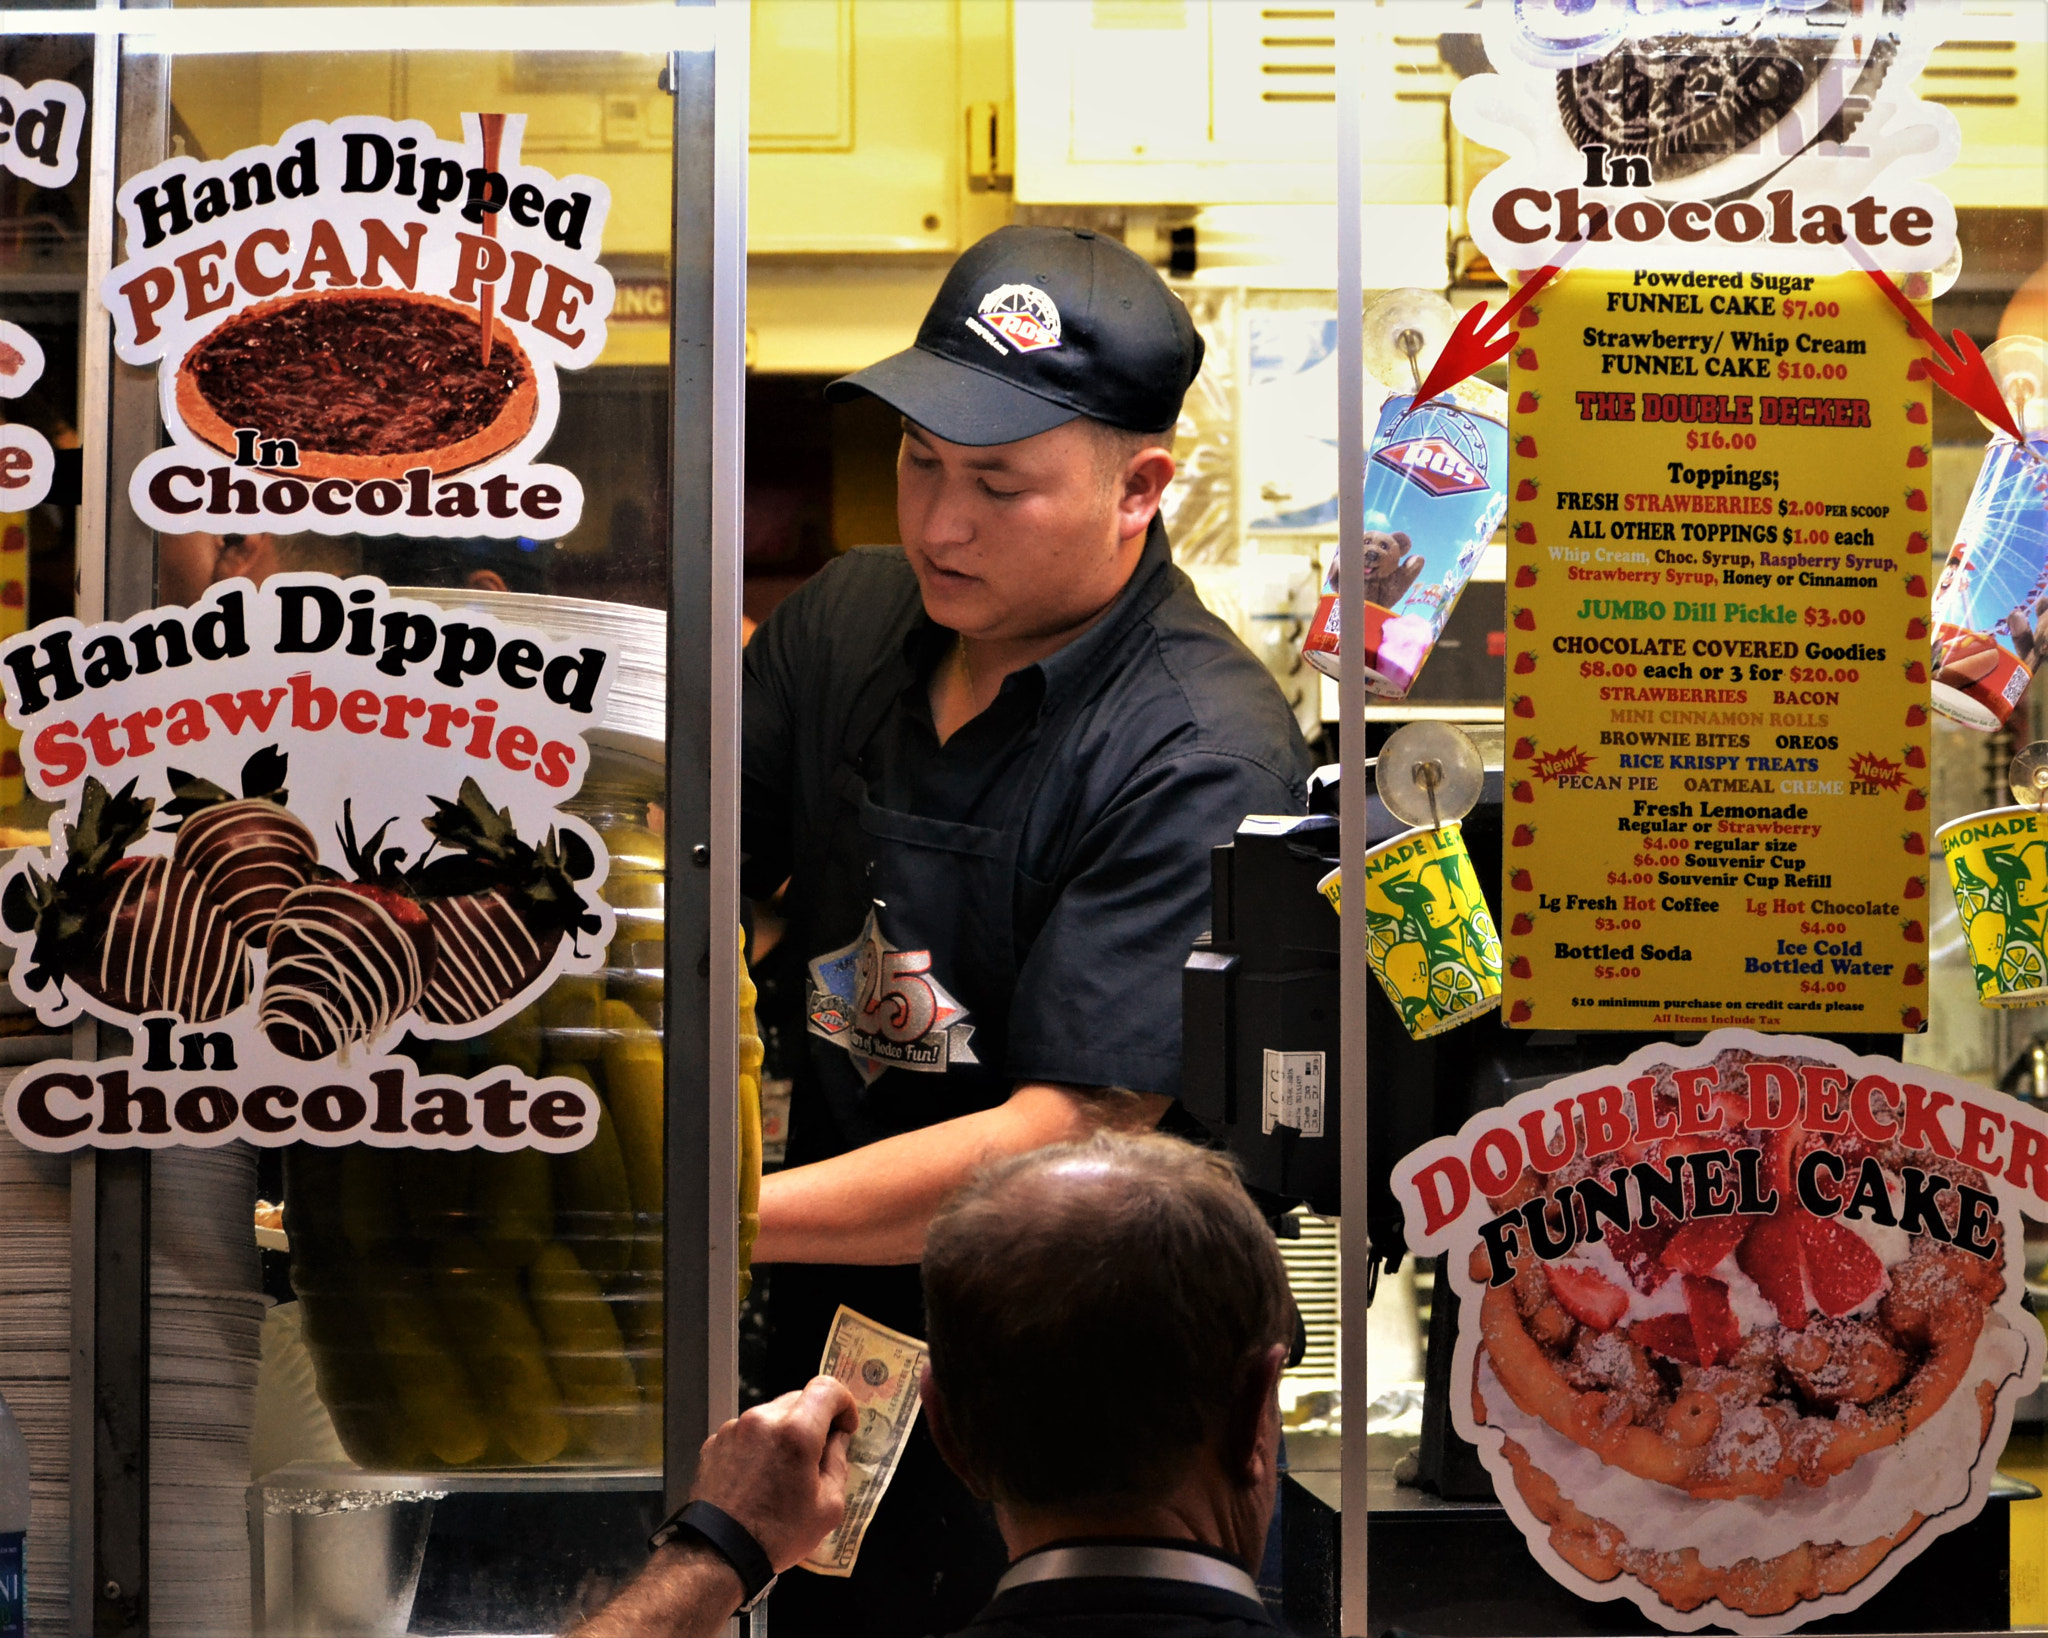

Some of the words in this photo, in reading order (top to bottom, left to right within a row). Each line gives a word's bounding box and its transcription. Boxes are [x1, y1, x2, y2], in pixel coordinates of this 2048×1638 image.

[1582, 144, 1652, 188] In
[135, 138, 318, 249] Hand
[342, 133, 592, 250] Dipped
[1492, 188, 1934, 246] Chocolate
[119, 219, 428, 346] PECAN
[451, 231, 594, 349] PIE
[1633, 269, 1743, 289] Powdered
[1751, 272, 1814, 295] Sugar
[1607, 292, 1703, 315] FUNNEL
[1710, 295, 1775, 316] CAKE
[1783, 298, 1840, 320] $7.00
[1583, 327, 1724, 354] Strawberry/
[1731, 330, 1789, 357] Whip
[1796, 333, 1867, 355] Cream
[1601, 354, 1698, 376] FUNNEL
[1705, 357, 1770, 378] CAKE
[1777, 360, 1847, 382] $10.00
[1576, 391, 1635, 421] THE
[1642, 393, 1753, 425] DOUBLE
[1760, 396, 1871, 428] DECKER
[233, 429, 299, 467] In
[1686, 429, 1757, 451] $16.00
[1667, 462, 1779, 491] Toppings;
[149, 465, 562, 520] Chocolate
[1556, 492, 1619, 511] FRESH
[1624, 494, 1773, 515] STRAWBERRIES
[1825, 505, 1848, 517] PER
[1851, 506, 1889, 518] SCOOP
[1569, 520, 1606, 539] ALL
[1611, 521, 1676, 541] OTHER
[1681, 523, 1777, 543] TOPPINGS
[1783, 527, 1829, 546] $1.00
[1834, 528, 1874, 546] each
[1549, 546, 1590, 564] Whip
[1595, 548, 1650, 566] Cream,
[1655, 549, 1698, 564] Choc.
[1702, 550, 1755, 568] Syrup,
[1760, 551, 1841, 570] Raspberry
[1846, 554, 1898, 572] Syrup,
[1568, 566, 1661, 585] Strawberry
[1666, 568, 1718, 587] Syrup,
[1723, 570, 1772, 588] Honey
[1777, 574, 1794, 587] or
[1799, 572, 1877, 588] Cinnamon
[1577, 599, 1666, 621] JUMBO
[1673, 601, 1717, 622] Dill
[1724, 603, 1797, 624] Pickle
[1804, 606, 1866, 627] $3.00
[4, 590, 250, 716] Hand
[273, 584, 607, 714] Dipped
[1553, 636, 1686, 656] CHOCOLATE
[1692, 639, 1799, 659] COVERED
[1805, 642, 1886, 661] Goodies
[1580, 660, 1637, 679] $8.00
[1644, 662, 1692, 679] each
[1700, 667, 1723, 680] or
[1730, 666, 1743, 682] 3
[1749, 664, 1783, 681] for
[1790, 666, 1859, 683] $20.00
[1600, 687, 1748, 703] STRAWBERRIES
[1773, 690, 1839, 705] BACON
[33, 670, 576, 788] Strawberries
[1610, 709, 1654, 723] MINI
[1659, 710, 1764, 727] CINNAMON
[1769, 712, 1829, 728] ROLLS
[1600, 731, 1690, 747] BROWNIE
[1696, 733, 1750, 748] BITES
[1775, 735, 1838, 750] OREOS
[1540, 751, 1579, 777] New!
[1619, 754, 1664, 769] RICE
[1669, 755, 1740, 771] KRISPY
[1746, 757, 1819, 772] TREATS
[1858, 761, 1898, 781] New!
[1557, 774, 1622, 790] PECAN
[1628, 776, 1658, 791] PIE
[1684, 778, 1774, 793] OATMEAL
[1780, 780, 1844, 795] CREME
[1849, 781, 1880, 796] PIE
[1633, 800, 1693, 817] Fresh
[1699, 801, 1808, 820] Lemonade
[1618, 817, 1687, 834] Regular
[1692, 822, 1712, 832] or
[1718, 820, 1822, 837] Strawberry
[1643, 837, 1689, 851] $4.00
[1694, 838, 1760, 853] regular
[1765, 839, 1797, 852] size
[1634, 853, 1680, 867] $6.00
[1685, 853, 1765, 868] Souvenir
[1770, 856, 1806, 871] Cup
[1607, 871, 1653, 885] $4.00
[1658, 871, 1738, 887] Souvenir
[1743, 874, 1779, 889] Cup
[1784, 874, 1832, 888] Refill
[1539, 894, 1561, 912] Lg
[1566, 894, 1617, 911] Fresh
[1623, 896, 1656, 911] Hot
[1662, 897, 1719, 912] Coffee
[1746, 898, 1767, 916] Lg
[1773, 898, 1806, 914] Hot
[1811, 899, 1899, 915] Chocolate
[1595, 917, 1641, 931] $3.00
[1800, 920, 1846, 935] $4.00
[1554, 943, 1634, 960] Bottled
[1640, 944, 1692, 961] Soda
[1777, 939, 1807, 956] Ice
[1813, 940, 1862, 957] Cold
[1594, 964, 1641, 979] $5.00
[1744, 957, 1824, 974] Bottled
[1830, 958, 1894, 976] Water
[1800, 980, 1846, 994] $4.00
[1571, 996, 1594, 1007] $10
[1598, 996, 1660, 1008] minimum
[1663, 998, 1722, 1010] purchase
[1726, 1001, 1742, 1009] on
[1745, 1000, 1783, 1010] credit
[1787, 1000, 1822, 1011] cards
[1825, 1001, 1864, 1012] please
[1653, 1014, 1670, 1023] All
[1675, 1014, 1707, 1024] Items
[1711, 1014, 1755, 1025] Include
[1759, 1015, 1780, 1025] Tax
[142, 1018, 239, 1071] In
[16, 1069, 586, 1140] Chocolate
[1411, 1064, 1726, 1236] DOUBLE
[1745, 1063, 2048, 1209] DECKER
[1477, 1147, 1779, 1288] FUNNEL
[1797, 1149, 2001, 1261] CAKE
